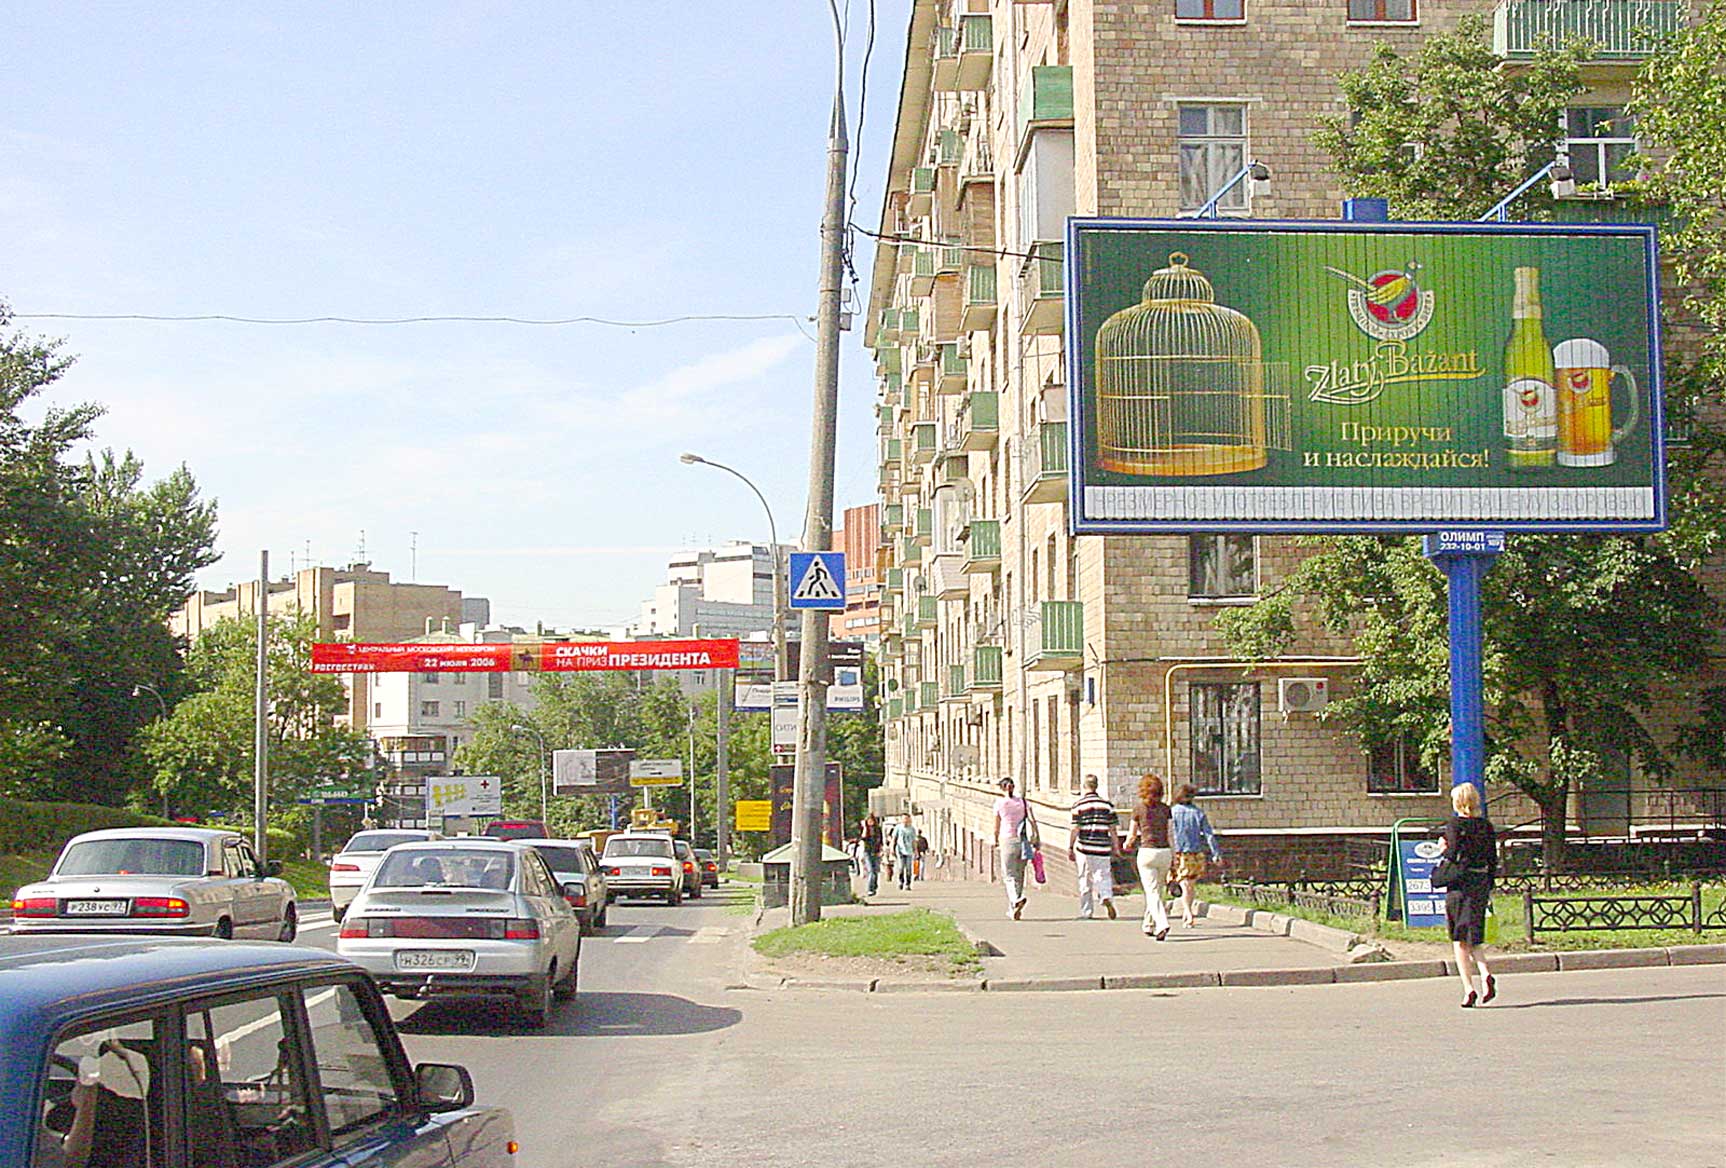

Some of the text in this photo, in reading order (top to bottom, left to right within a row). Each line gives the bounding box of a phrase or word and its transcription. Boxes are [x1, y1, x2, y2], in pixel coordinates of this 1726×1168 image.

[1376, 340, 1481, 376] Bažant
[1341, 421, 1451, 447] Приручи
[1303, 449, 1491, 469] и наслаждайся!
[1094, 491, 1206, 511] ЧРЕЗМЕРНОЕ
[1440, 531, 1485, 542] ОЛИМП
[1439, 542, 1486, 551] 232-10-01
[556, 646, 608, 657] СКАЧКИ
[424, 657, 496, 668] 22 июля 2006
[556, 652, 711, 668] НА ПРИЗ ПРЕЗИДЕНТА
